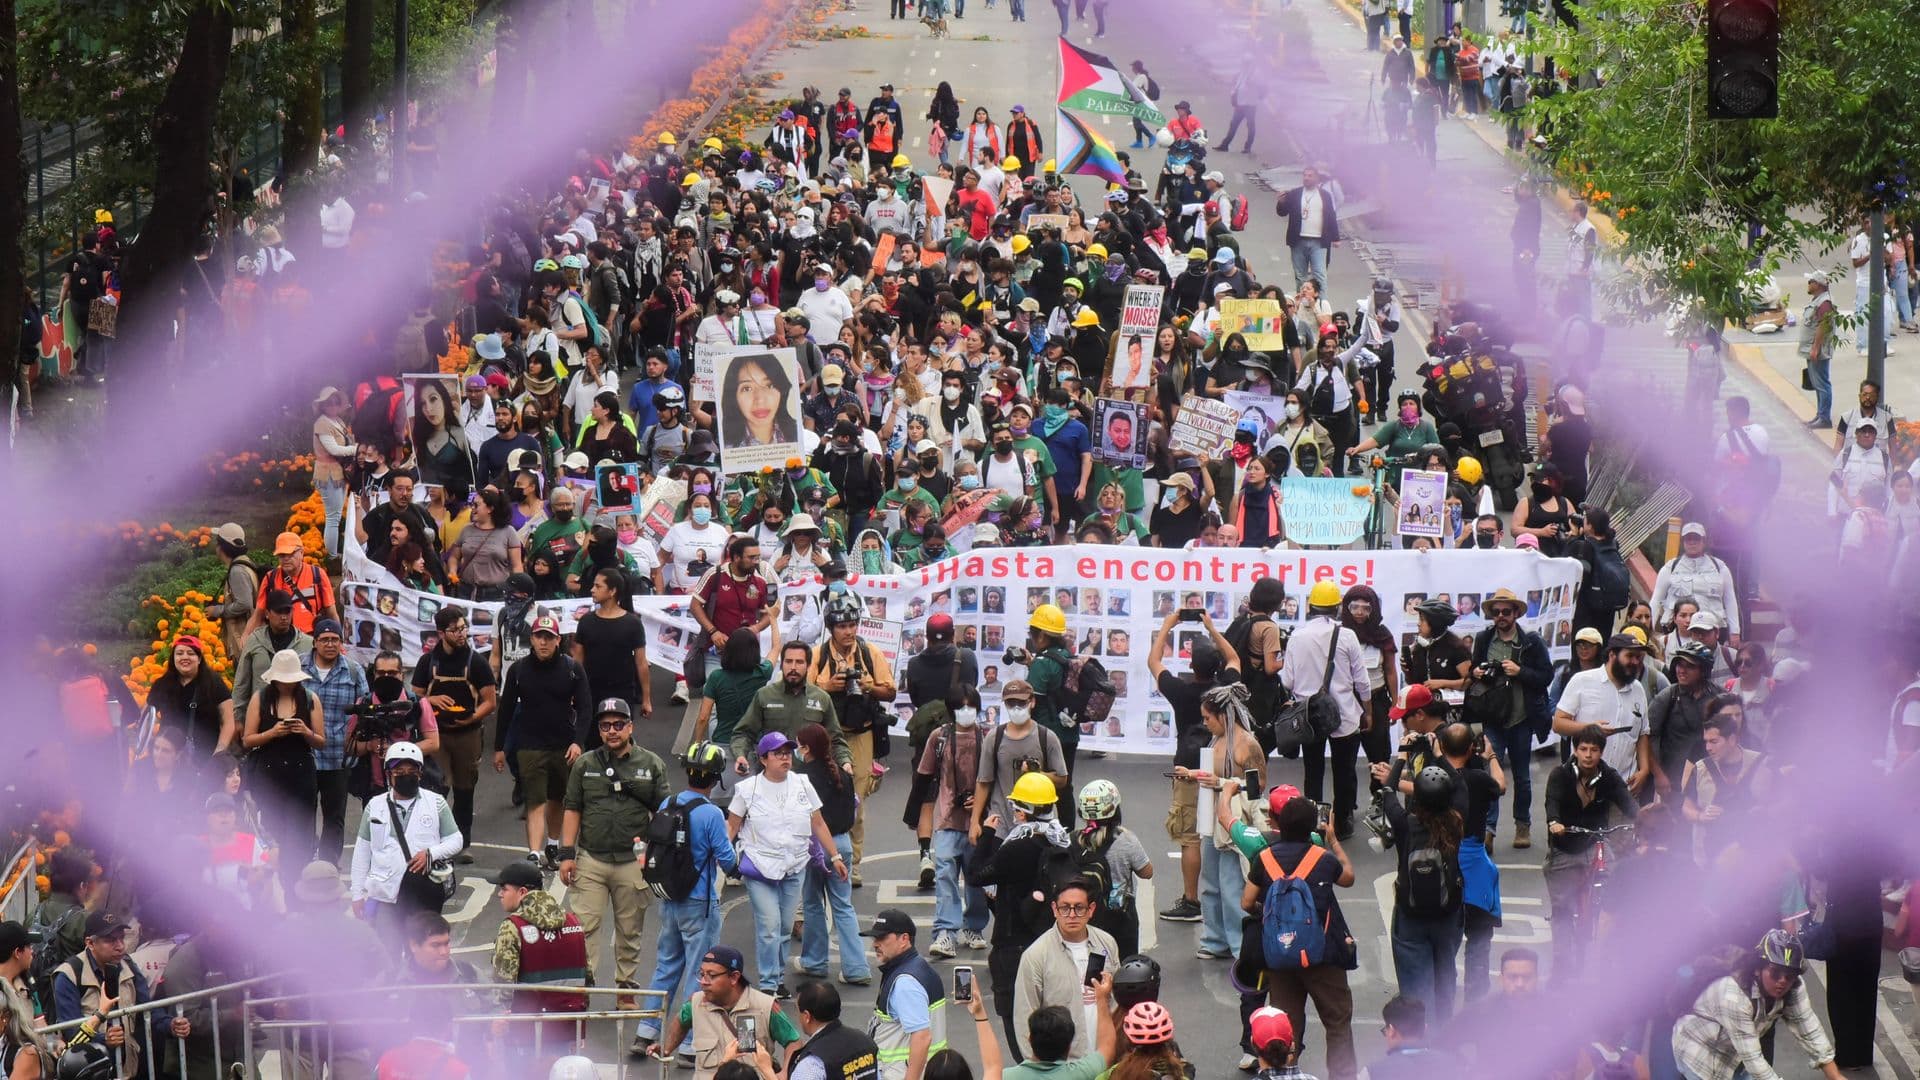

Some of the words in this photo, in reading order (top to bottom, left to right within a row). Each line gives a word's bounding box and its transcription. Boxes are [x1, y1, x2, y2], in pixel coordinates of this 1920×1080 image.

[1087, 97, 1162, 122] PALESTINE
[1128, 291, 1151, 306] WHERE
[1152, 292, 1160, 307] IS
[1124, 307, 1158, 326] MOISES
[921, 554, 1055, 586] ¡Hasta
[1077, 555, 1376, 587] encontrarles!
